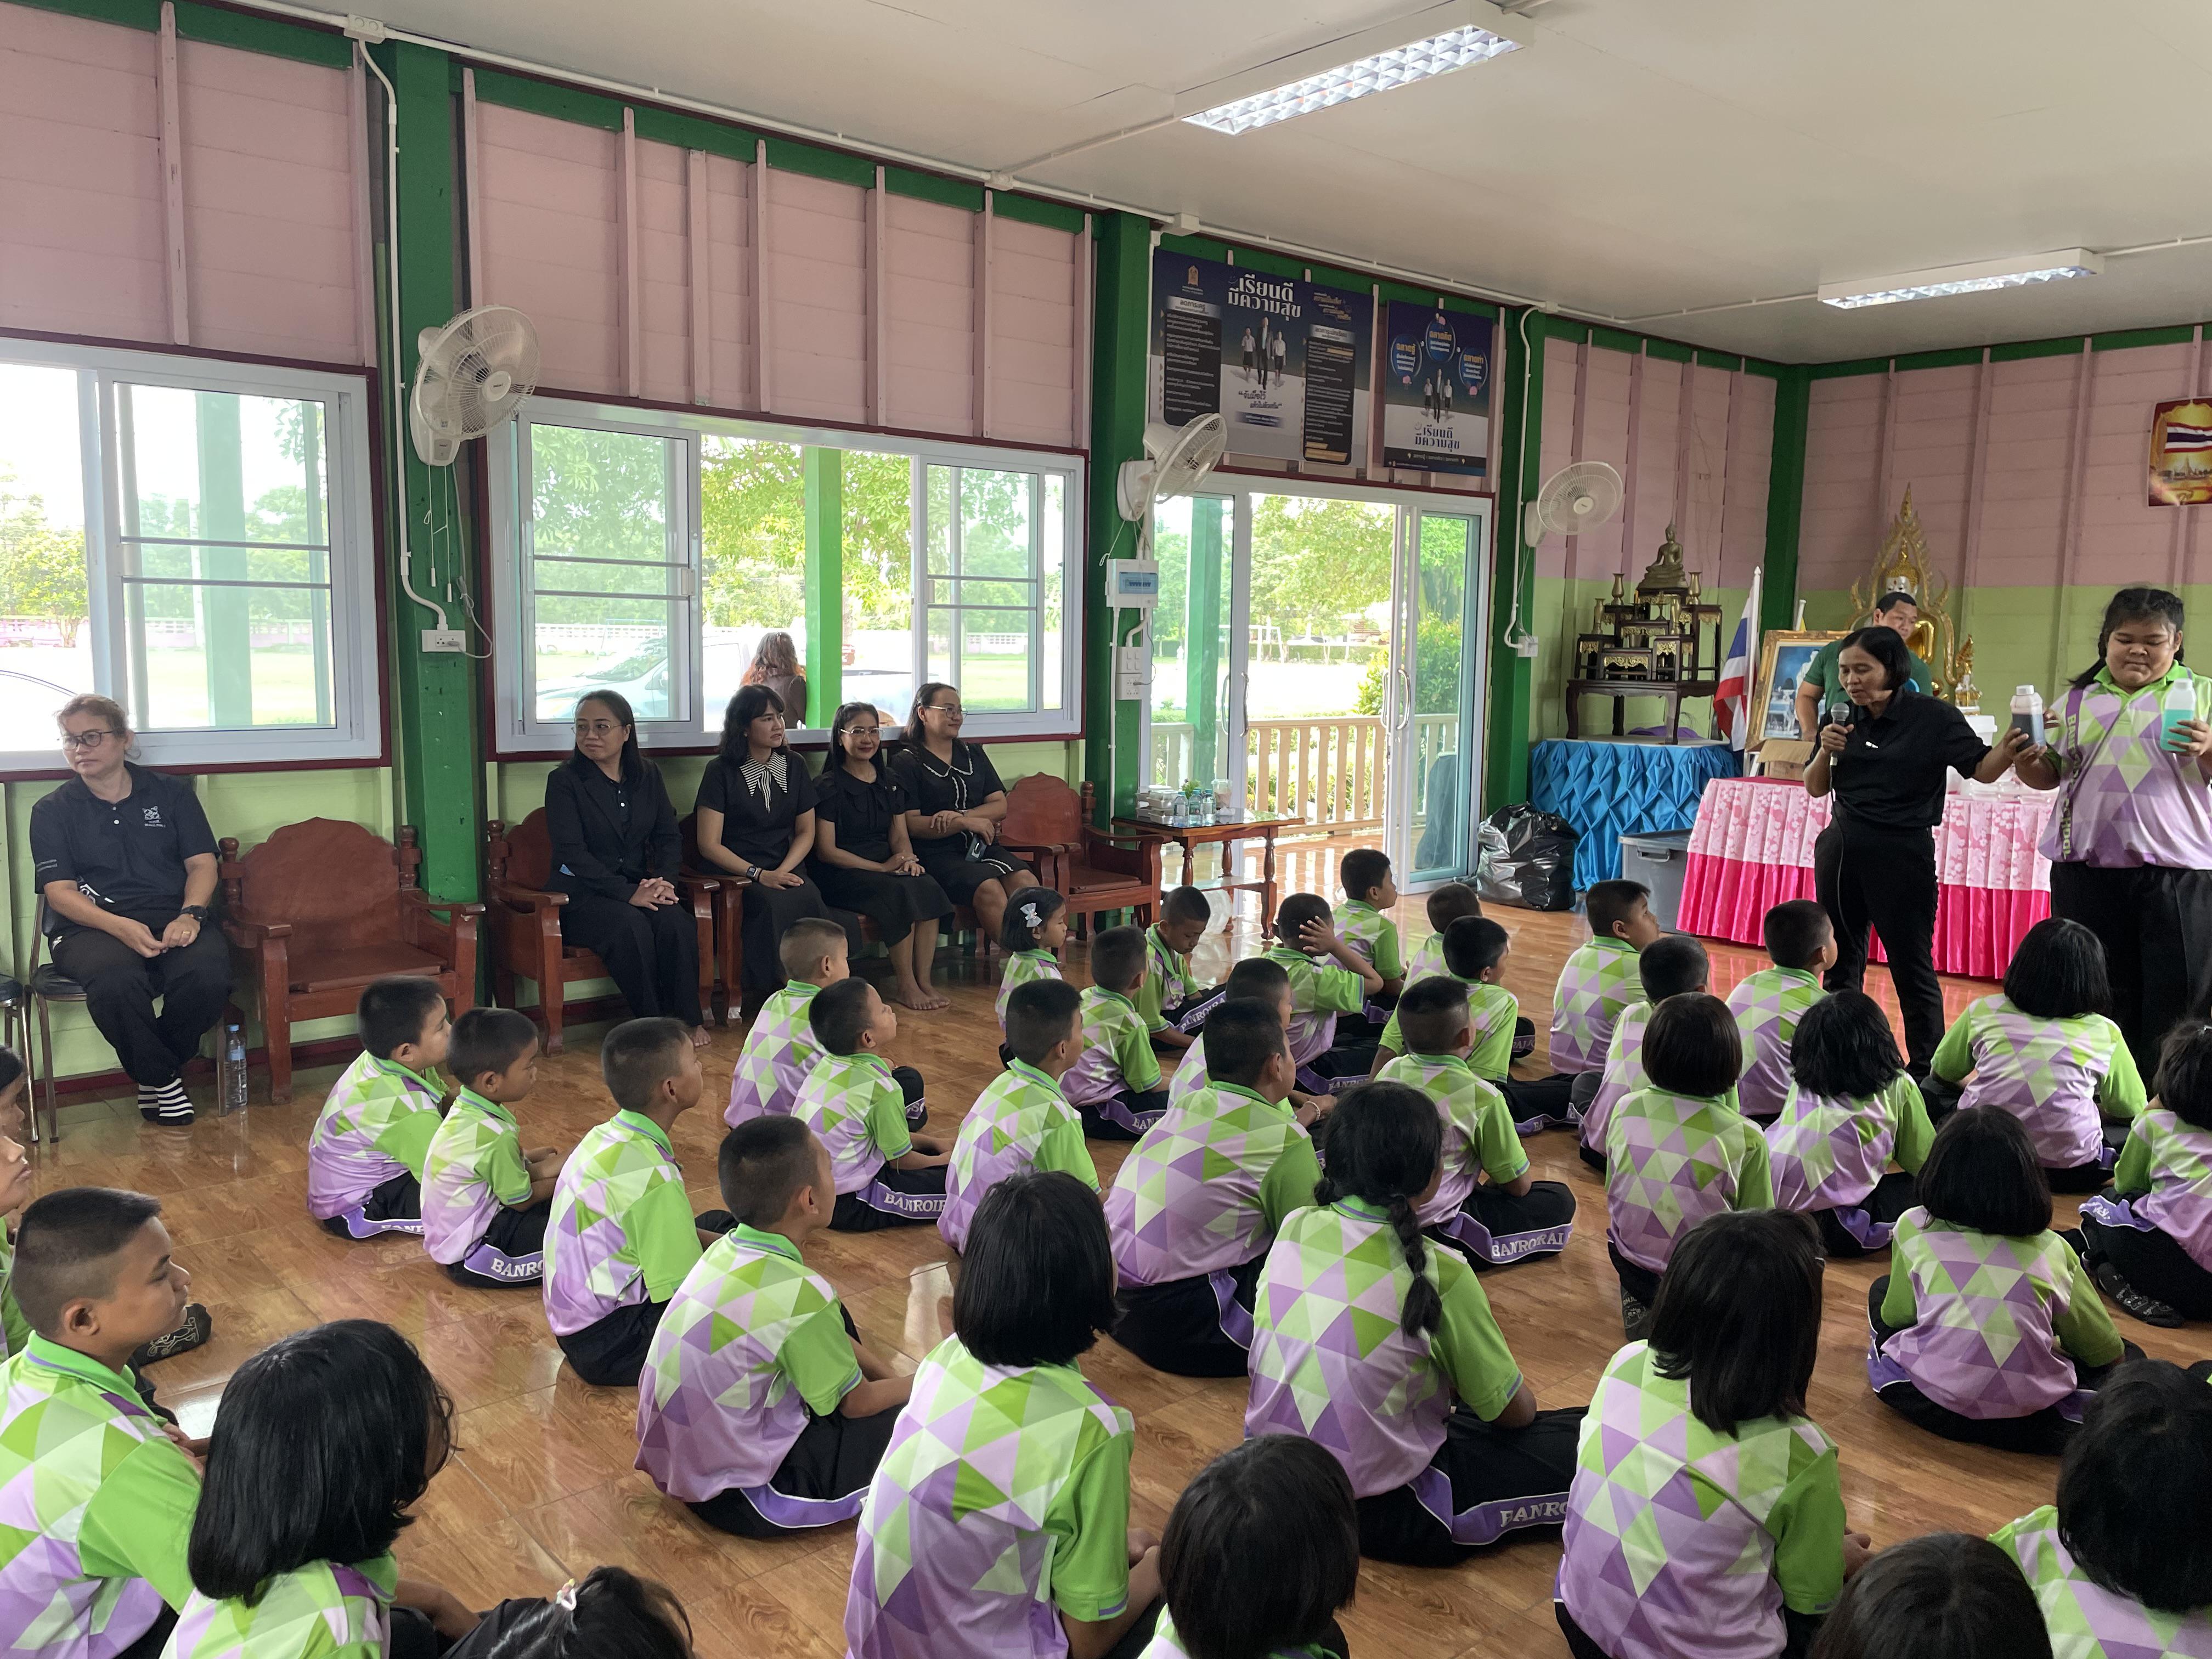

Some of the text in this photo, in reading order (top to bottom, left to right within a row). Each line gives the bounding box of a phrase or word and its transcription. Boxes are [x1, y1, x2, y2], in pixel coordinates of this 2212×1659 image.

[1239, 274, 1294, 302] เรียนดี
[1228, 287, 1301, 321] มีความสุข
[1414, 433, 1460, 452] มีความสุข
[1423, 425, 1453, 439] เรียนดี
